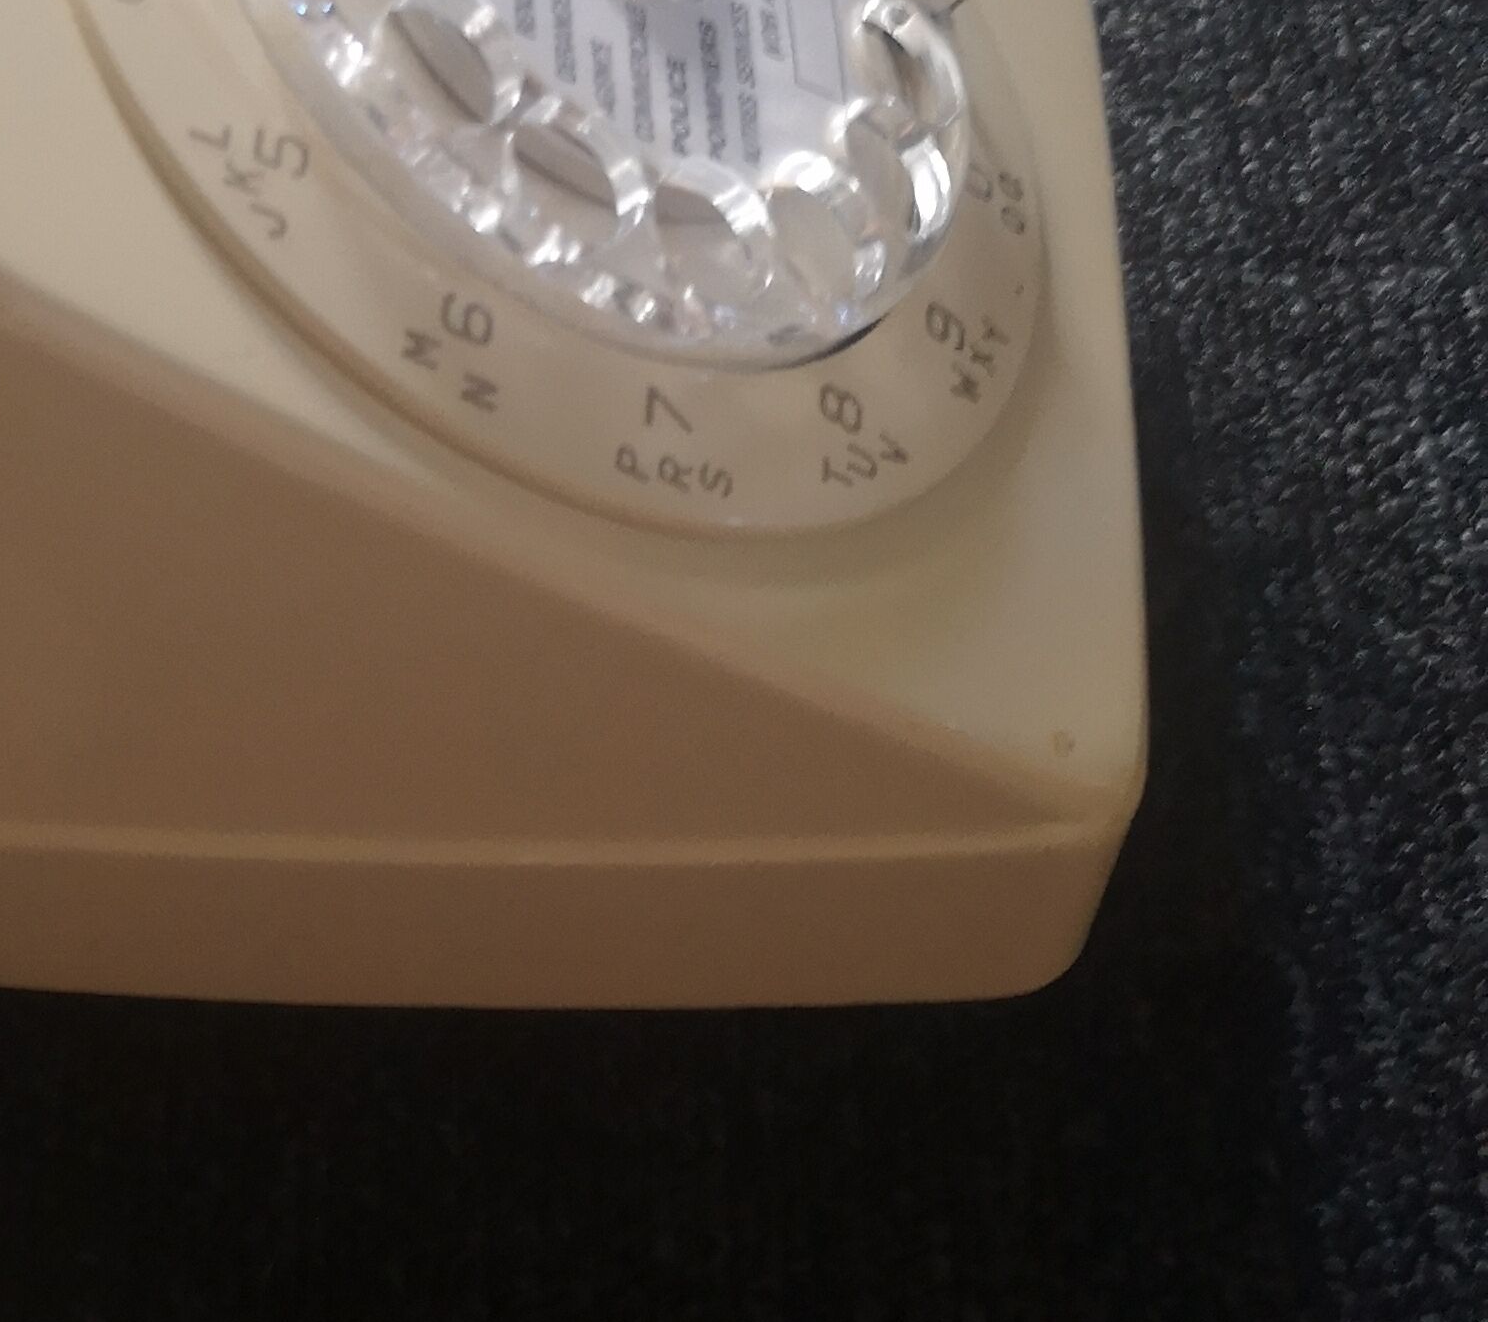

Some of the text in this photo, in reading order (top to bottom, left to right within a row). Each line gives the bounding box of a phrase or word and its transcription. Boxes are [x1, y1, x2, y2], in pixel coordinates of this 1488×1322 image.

[253, 127, 310, 178] 5
[439, 291, 495, 346] 6
[925, 300, 965, 351] 9
[643, 384, 693, 435] 7
[818, 382, 864, 434] 8
[614, 443, 734, 499] PRS
